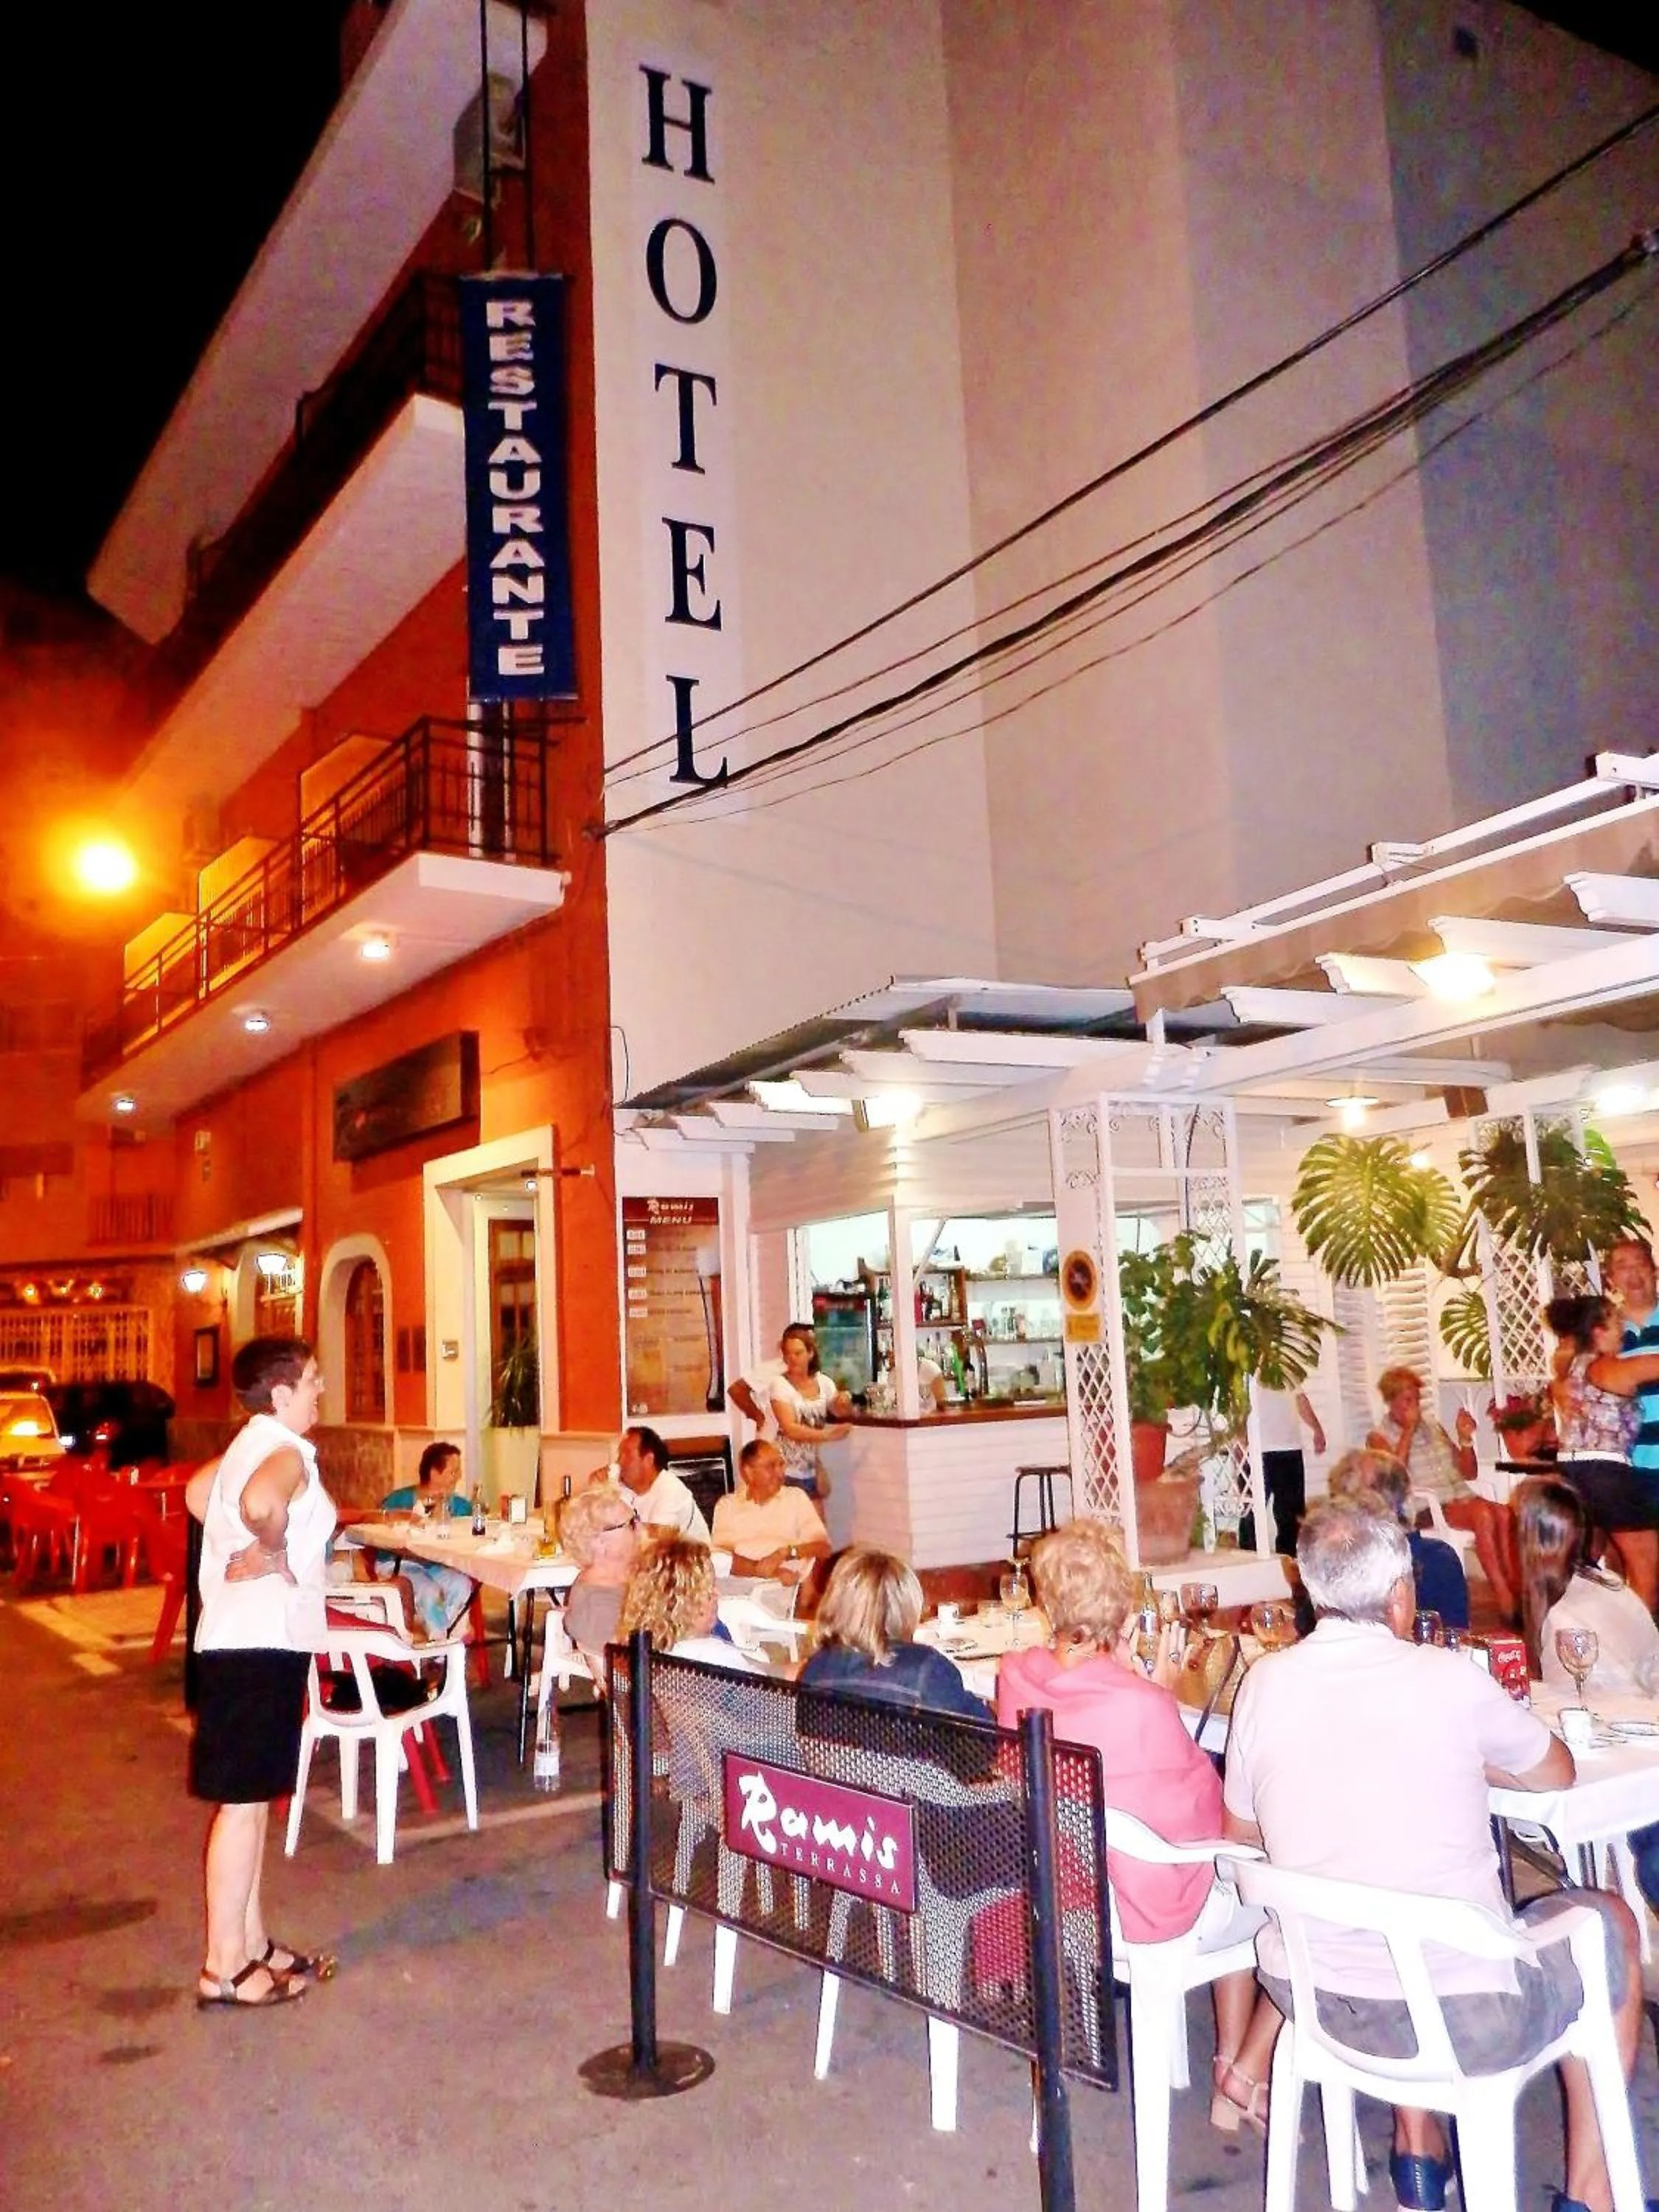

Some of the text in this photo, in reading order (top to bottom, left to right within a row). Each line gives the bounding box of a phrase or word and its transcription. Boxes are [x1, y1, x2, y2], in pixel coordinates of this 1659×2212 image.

[485, 300, 545, 676] RESTAURANTE
[639, 63, 728, 787] HOTEL
[737, 1770, 899, 1870] Ramis
[780, 1842, 901, 1895] TERRASSA
